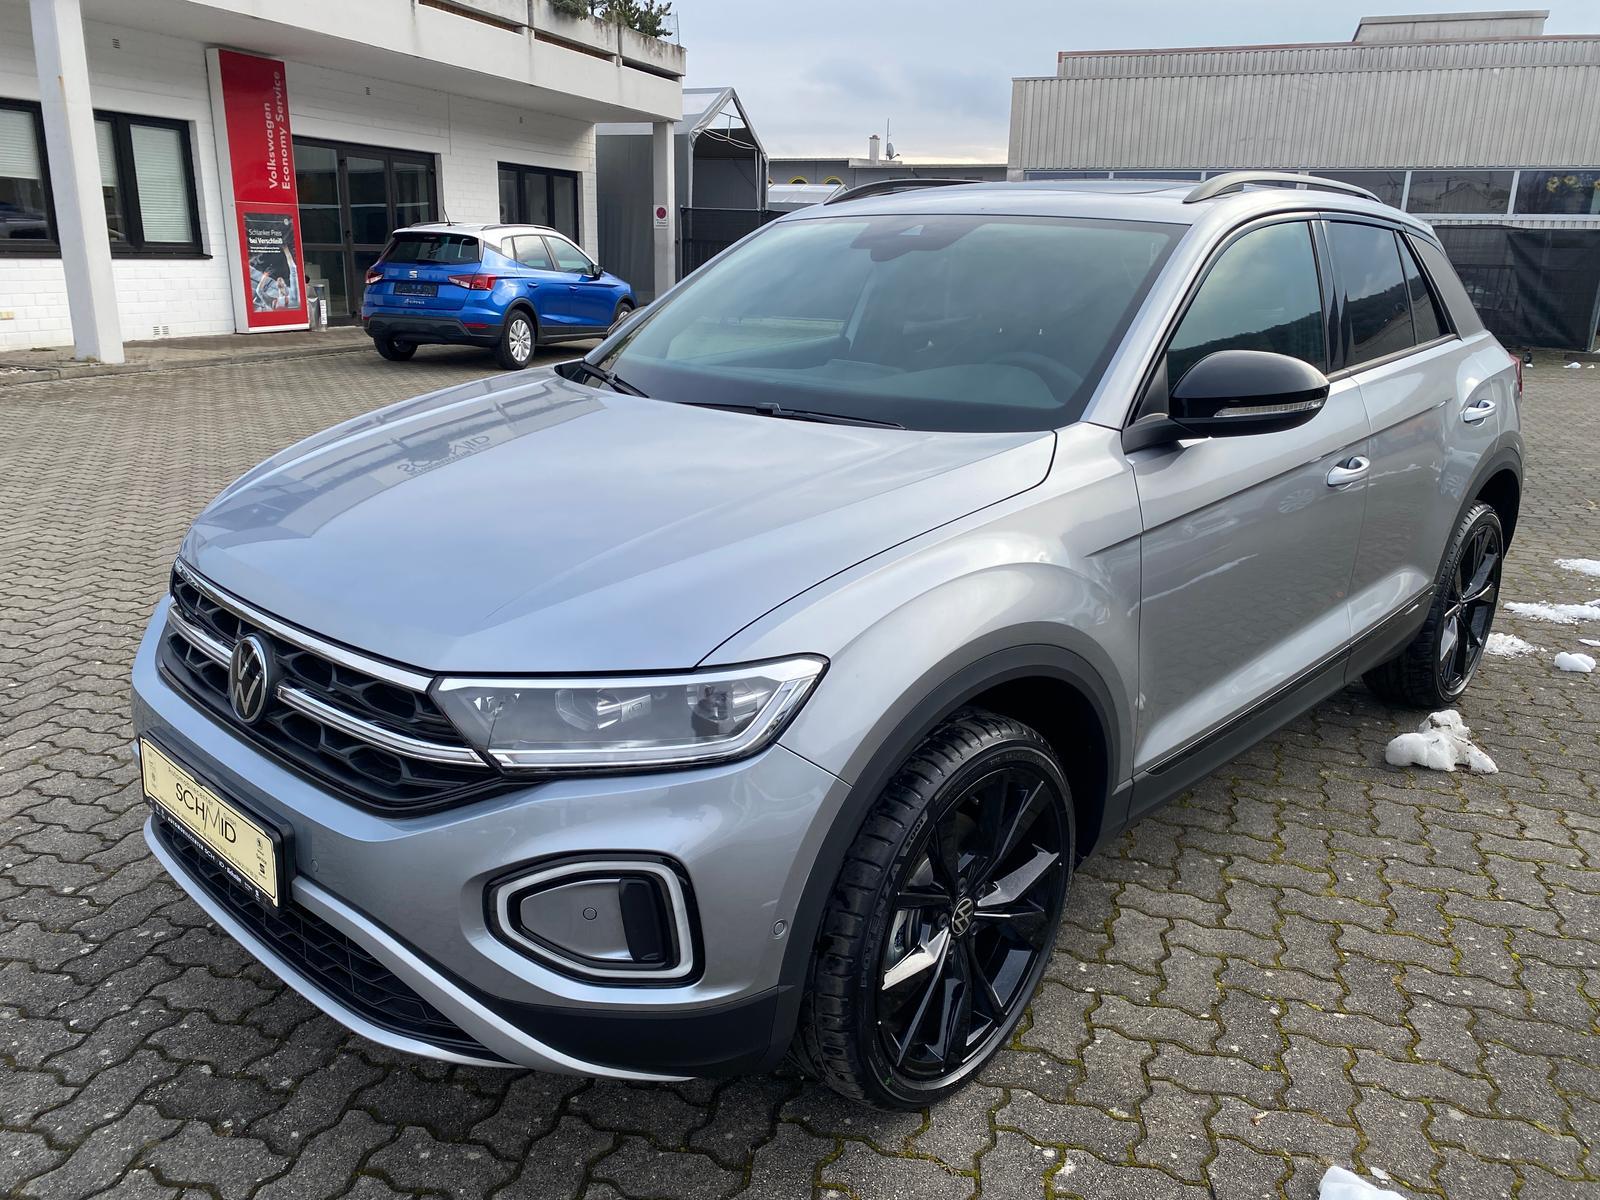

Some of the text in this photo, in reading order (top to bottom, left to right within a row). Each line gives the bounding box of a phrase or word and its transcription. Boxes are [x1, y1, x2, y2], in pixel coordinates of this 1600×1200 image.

[264, 103, 278, 188] Volkswagen
[273, 71, 291, 190] Economy Service
[175, 782, 237, 844] SCHMID
